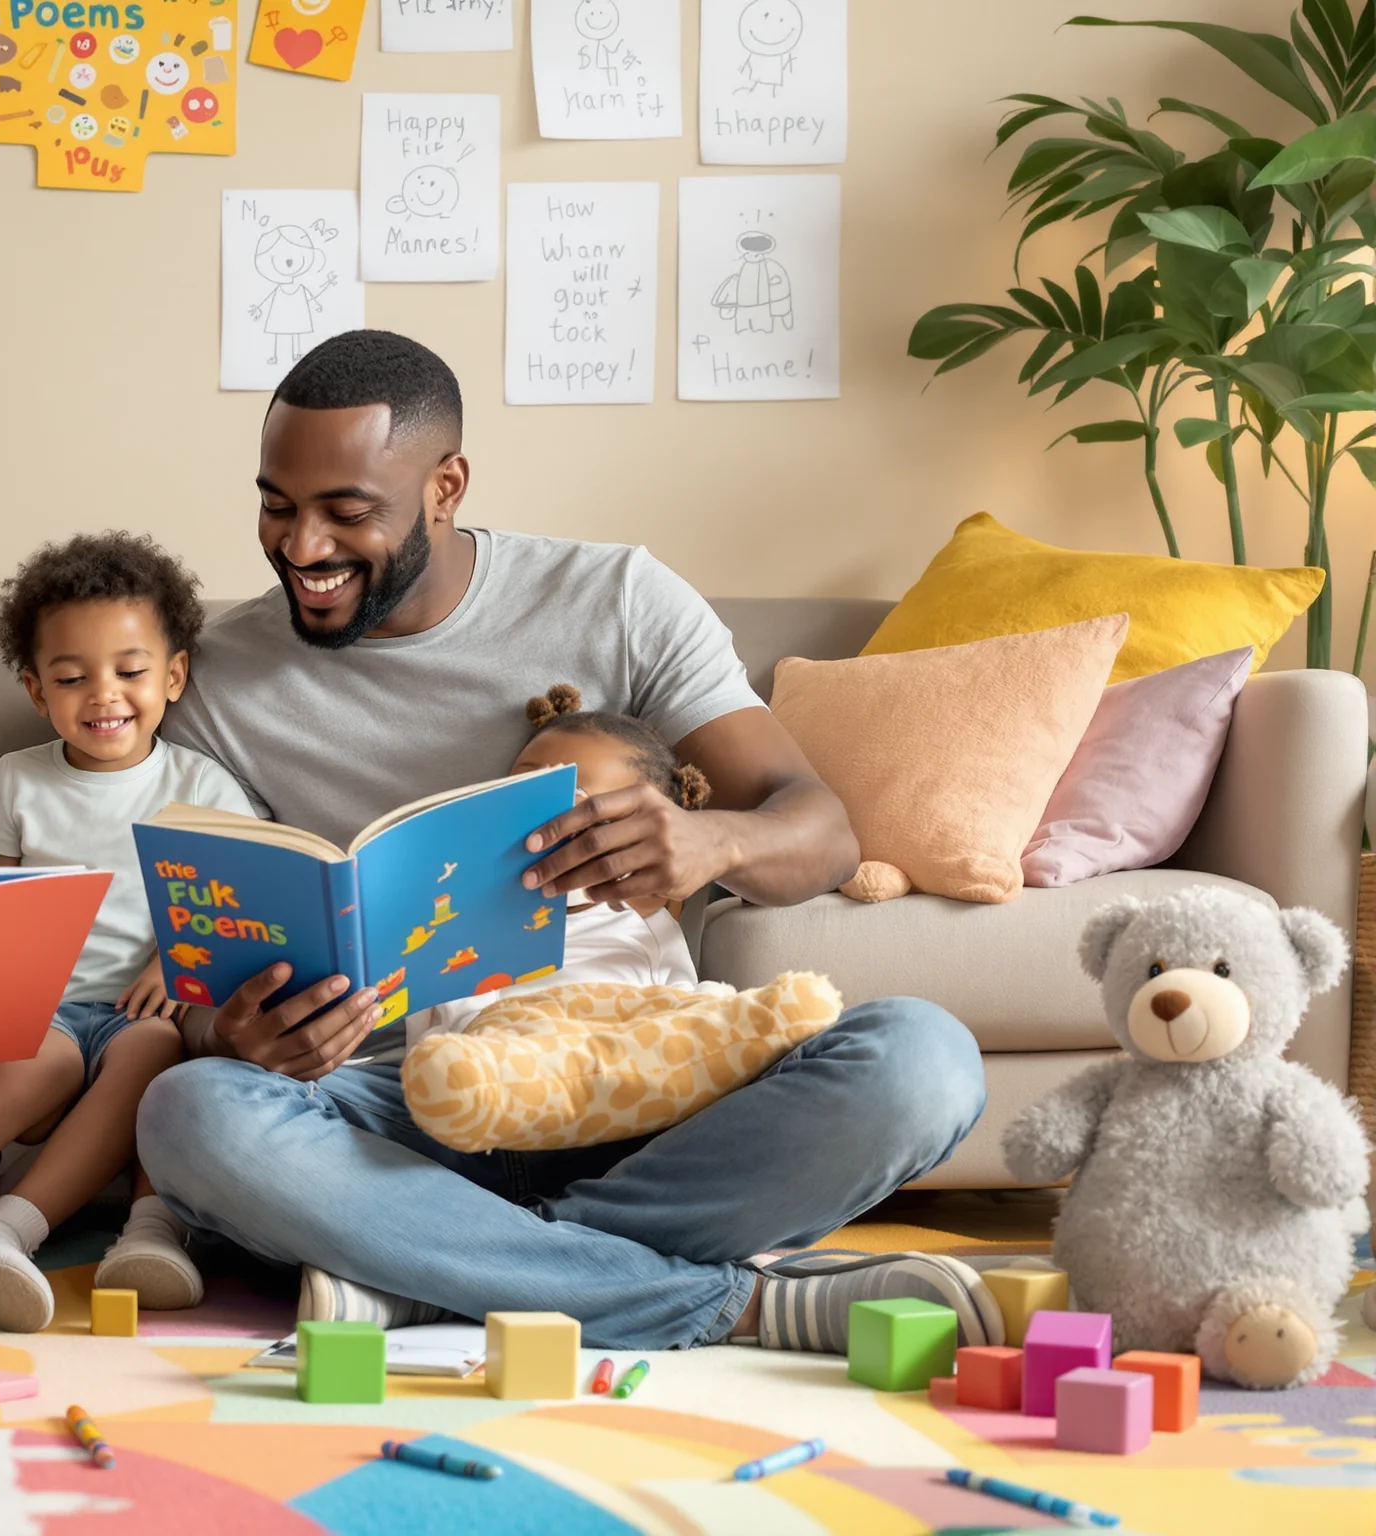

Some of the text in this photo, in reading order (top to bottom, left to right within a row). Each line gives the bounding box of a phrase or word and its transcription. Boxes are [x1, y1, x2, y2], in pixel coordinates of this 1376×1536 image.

[10, 0, 145, 30] Poems
[547, 196, 594, 221] How
[167, 879, 241, 909] Fuk
[167, 905, 287, 945] Poems
